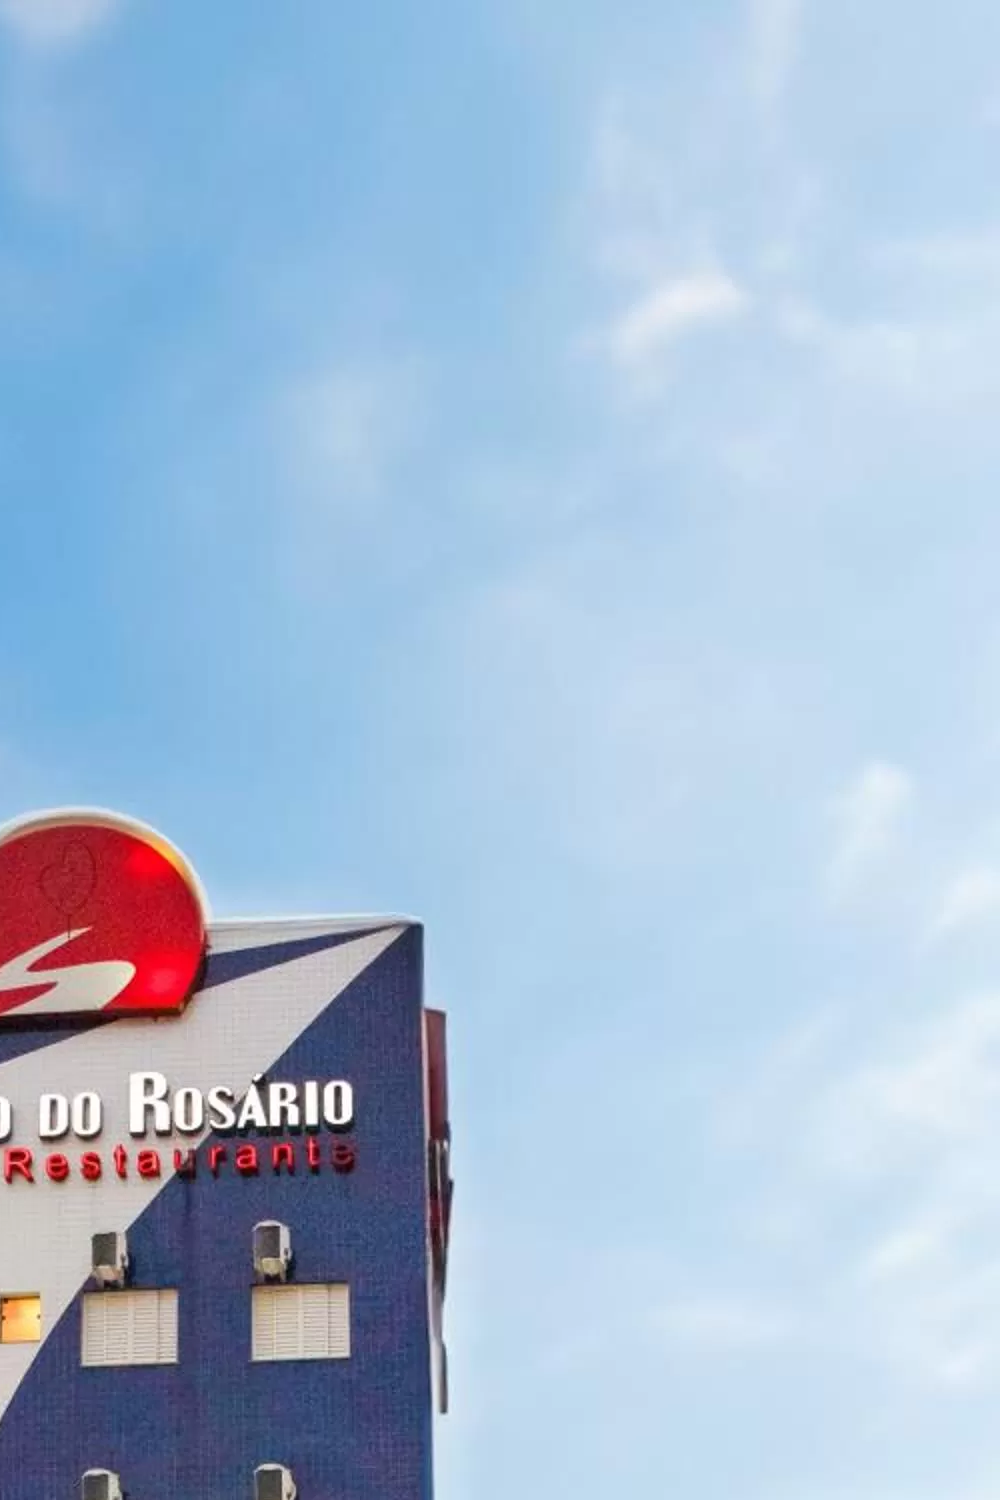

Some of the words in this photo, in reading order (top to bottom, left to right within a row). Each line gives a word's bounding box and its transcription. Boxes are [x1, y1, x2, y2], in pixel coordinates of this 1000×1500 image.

[38, 1091, 101, 1140] DO
[128, 1071, 353, 1136] ROSÁRIO
[3, 1134, 356, 1190] Restaurante
